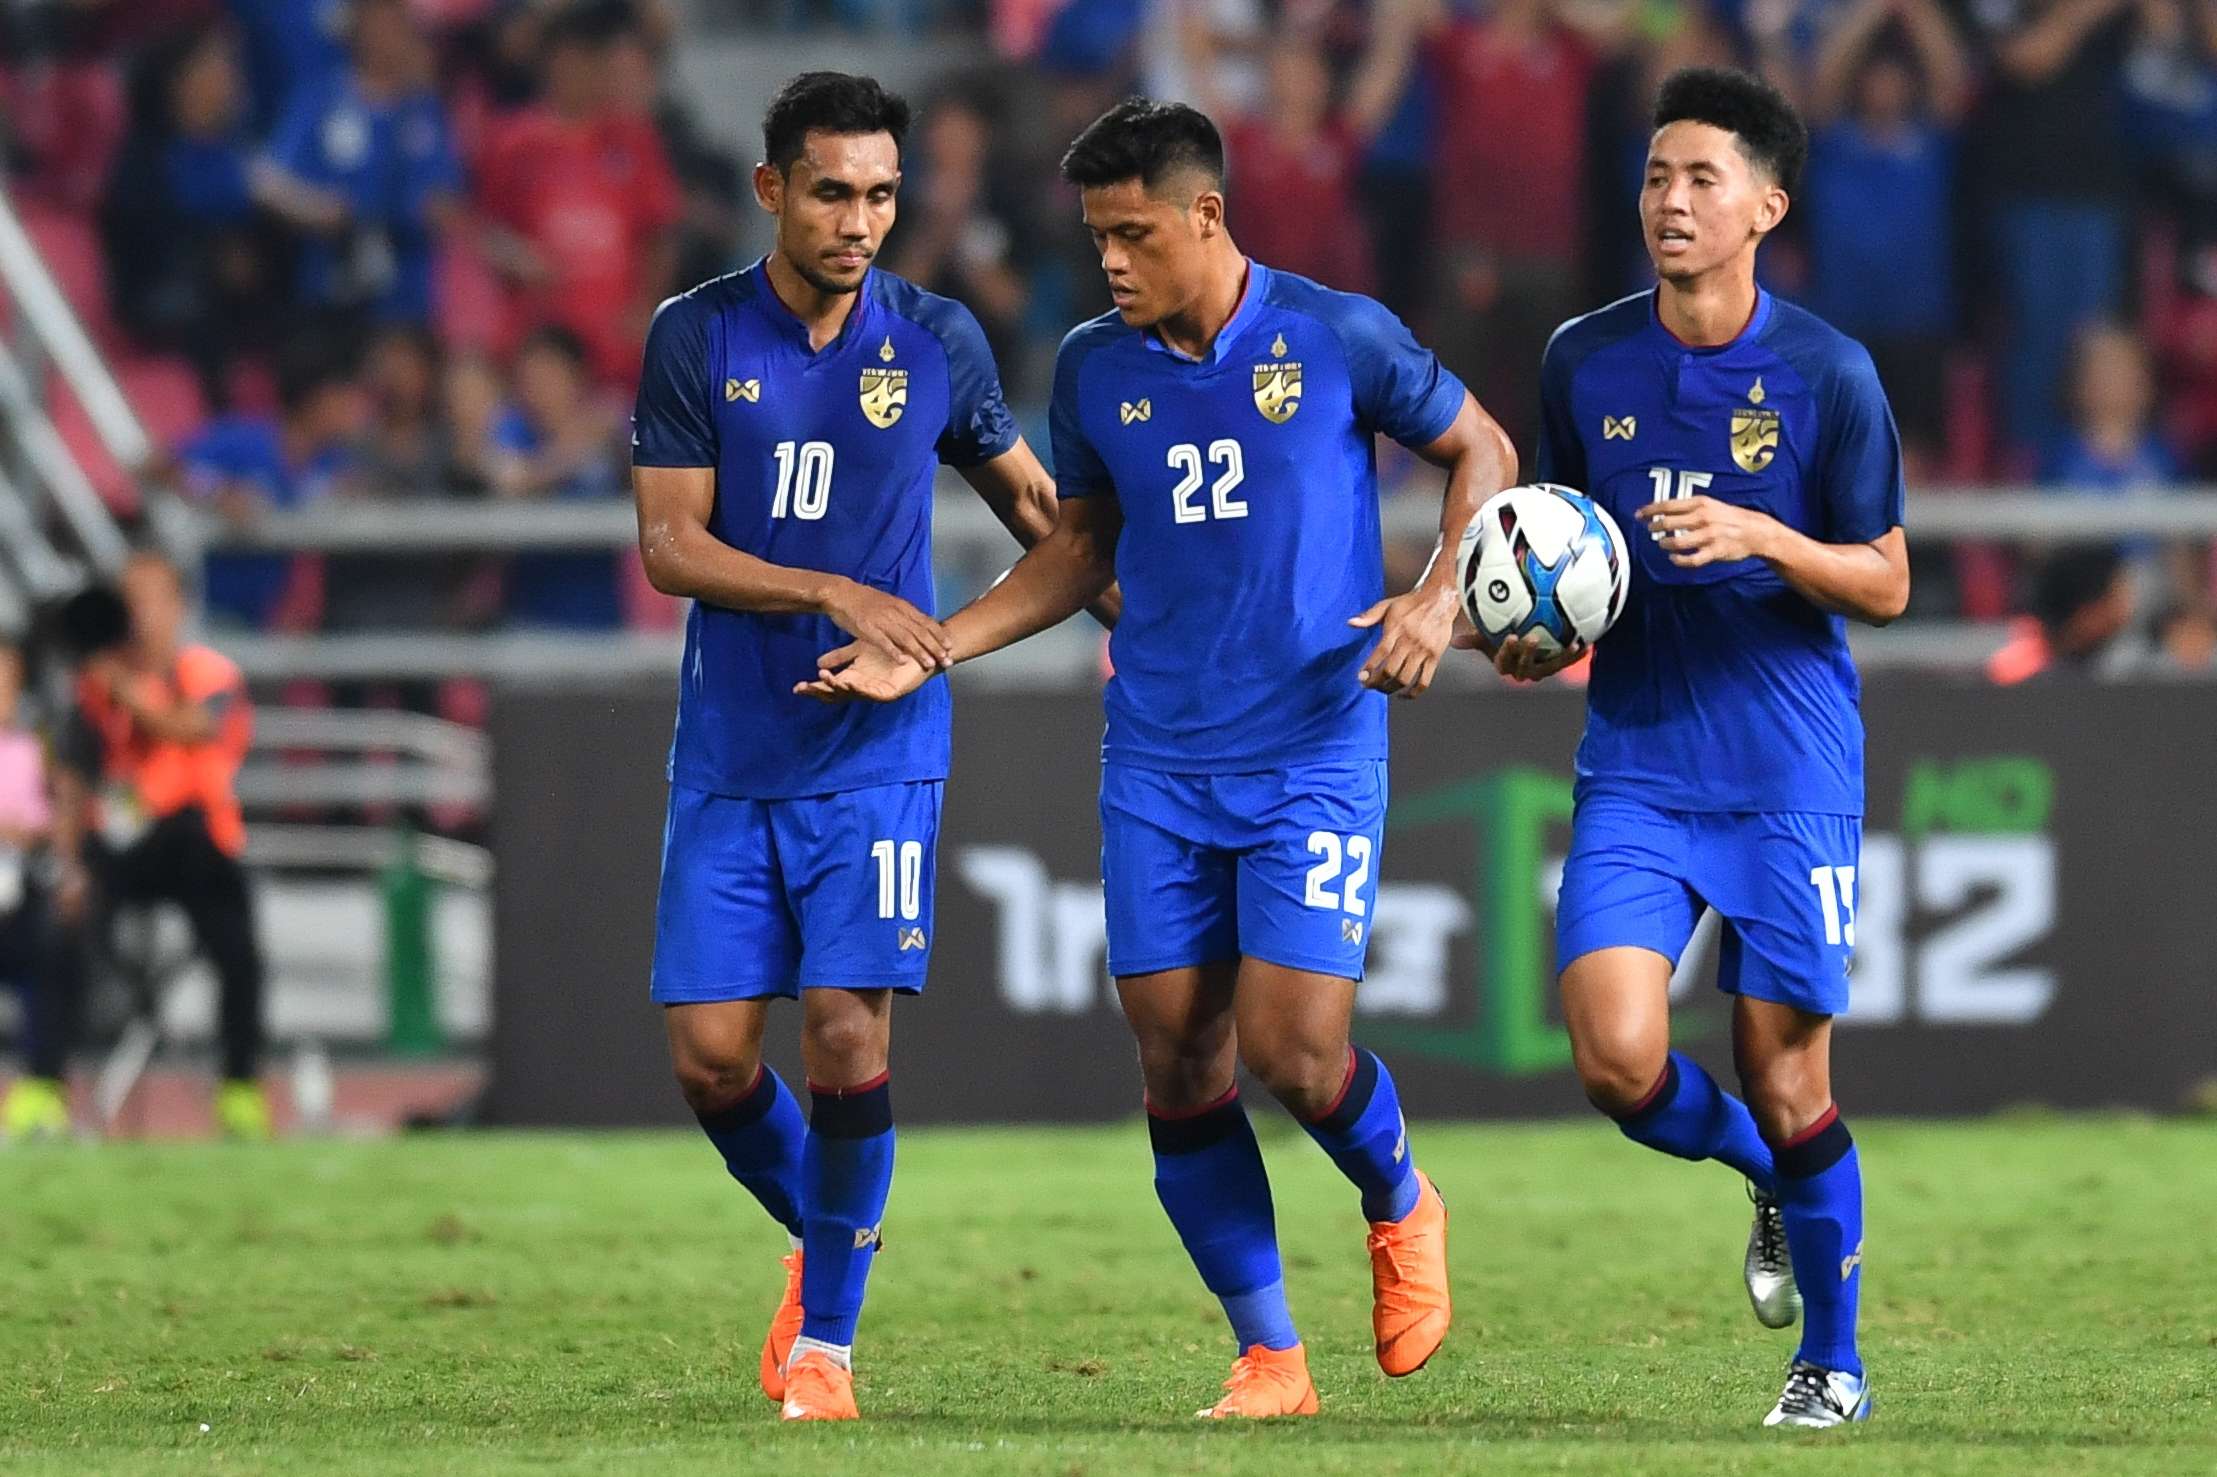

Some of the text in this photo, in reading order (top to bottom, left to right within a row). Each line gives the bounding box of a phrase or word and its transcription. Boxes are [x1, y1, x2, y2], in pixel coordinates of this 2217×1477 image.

[771, 441, 835, 520] 10
[1167, 438, 1248, 524] 22
[871, 839, 922, 920] 10
[1304, 831, 1372, 917] 22
